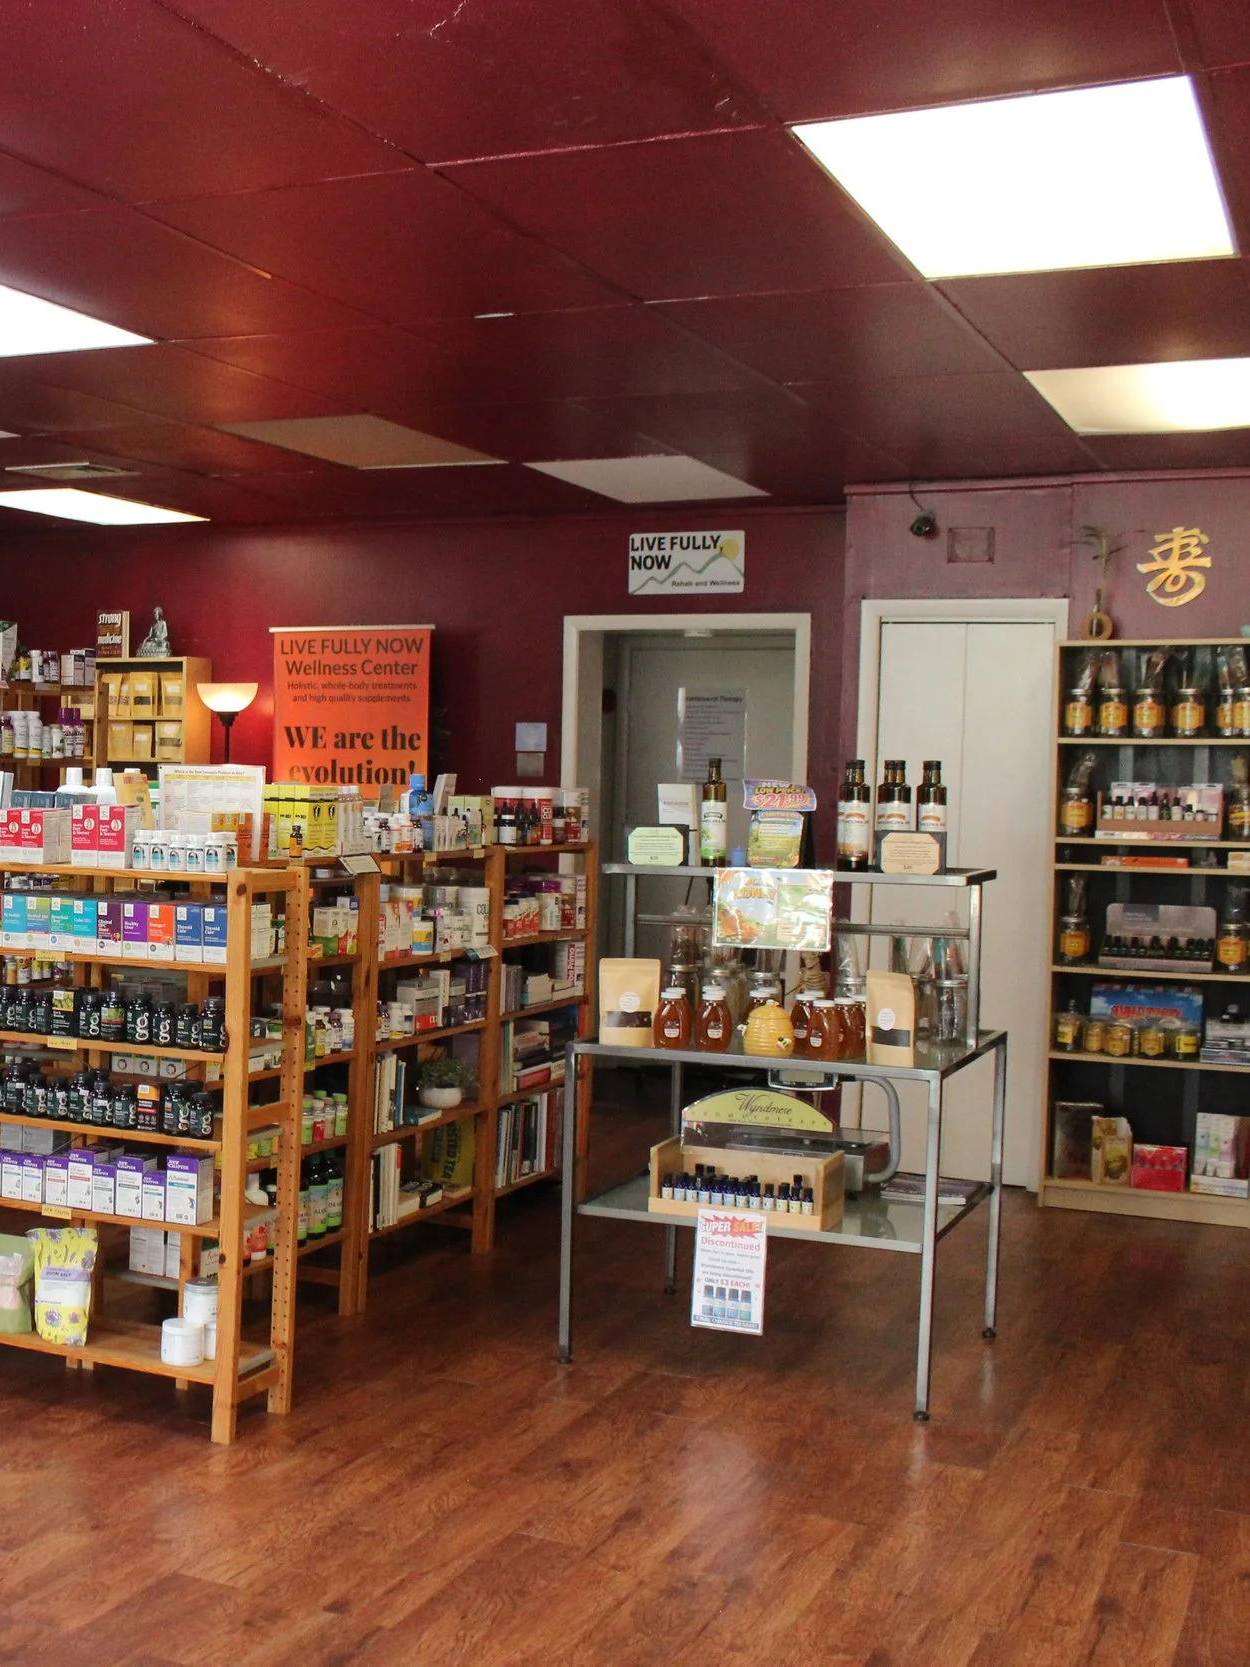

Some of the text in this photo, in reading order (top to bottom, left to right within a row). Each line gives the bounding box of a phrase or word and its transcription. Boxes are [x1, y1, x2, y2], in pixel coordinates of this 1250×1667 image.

[631, 535, 721, 552] LIVE FULLY
[630, 555, 672, 570] NOW
[98, 613, 122, 627] strong
[97, 633, 122, 644] medicine
[280, 638, 425, 655] LIVE FULLY NOW
[285, 660, 418, 676] Wellness Center
[287, 681, 417, 691] Holistic, whole-body treatments
[292, 694, 307, 702] and
[309, 694, 327, 704] high
[328, 694, 357, 704] quality
[284, 726, 421, 750] WE are the
[289, 759, 415, 785] evolution!
[735, 1093, 792, 1115] Wyndmere
[700, 1221, 764, 1233] SUPER SALE!
[701, 1236, 761, 1251] Discontinued
